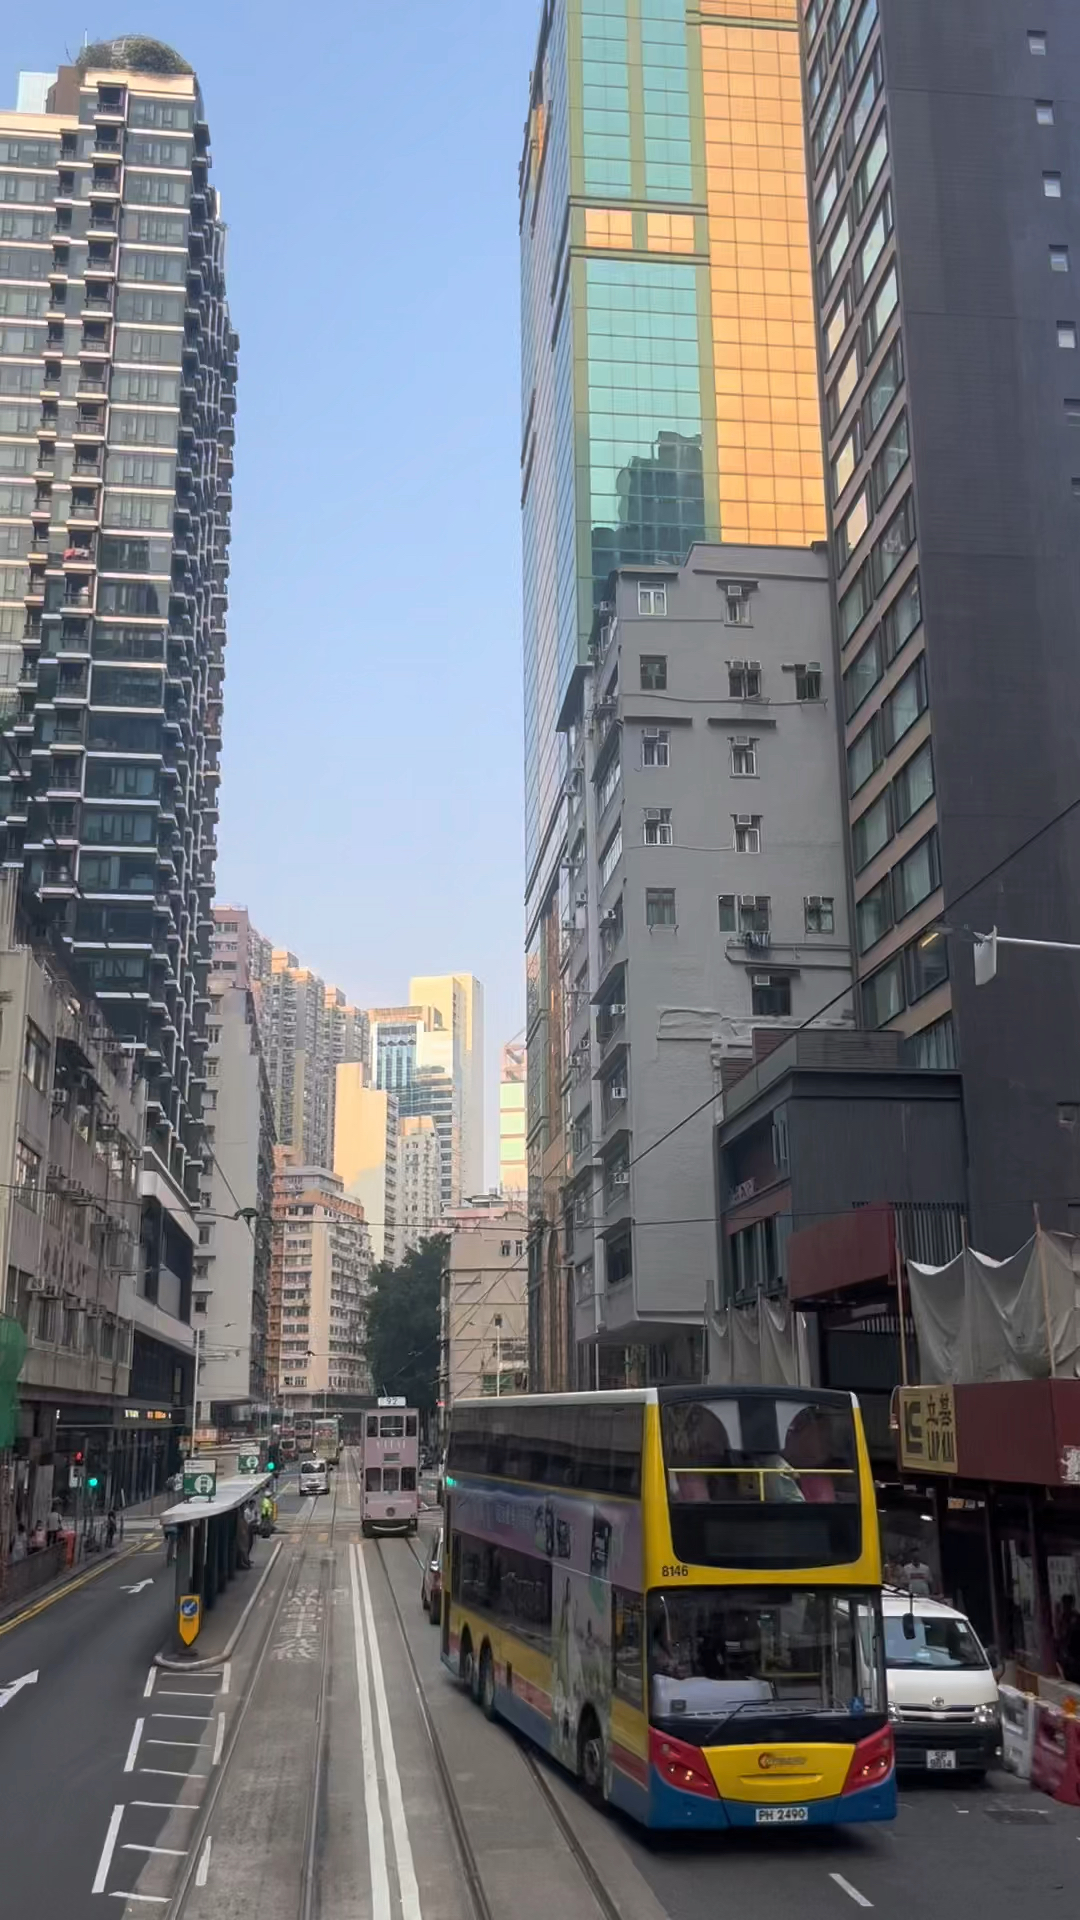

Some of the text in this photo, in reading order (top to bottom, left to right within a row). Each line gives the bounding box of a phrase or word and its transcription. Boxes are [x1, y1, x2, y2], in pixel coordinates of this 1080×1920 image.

[662, 1565, 688, 1577] 8146
[759, 1808, 806, 1821] PH 2490
